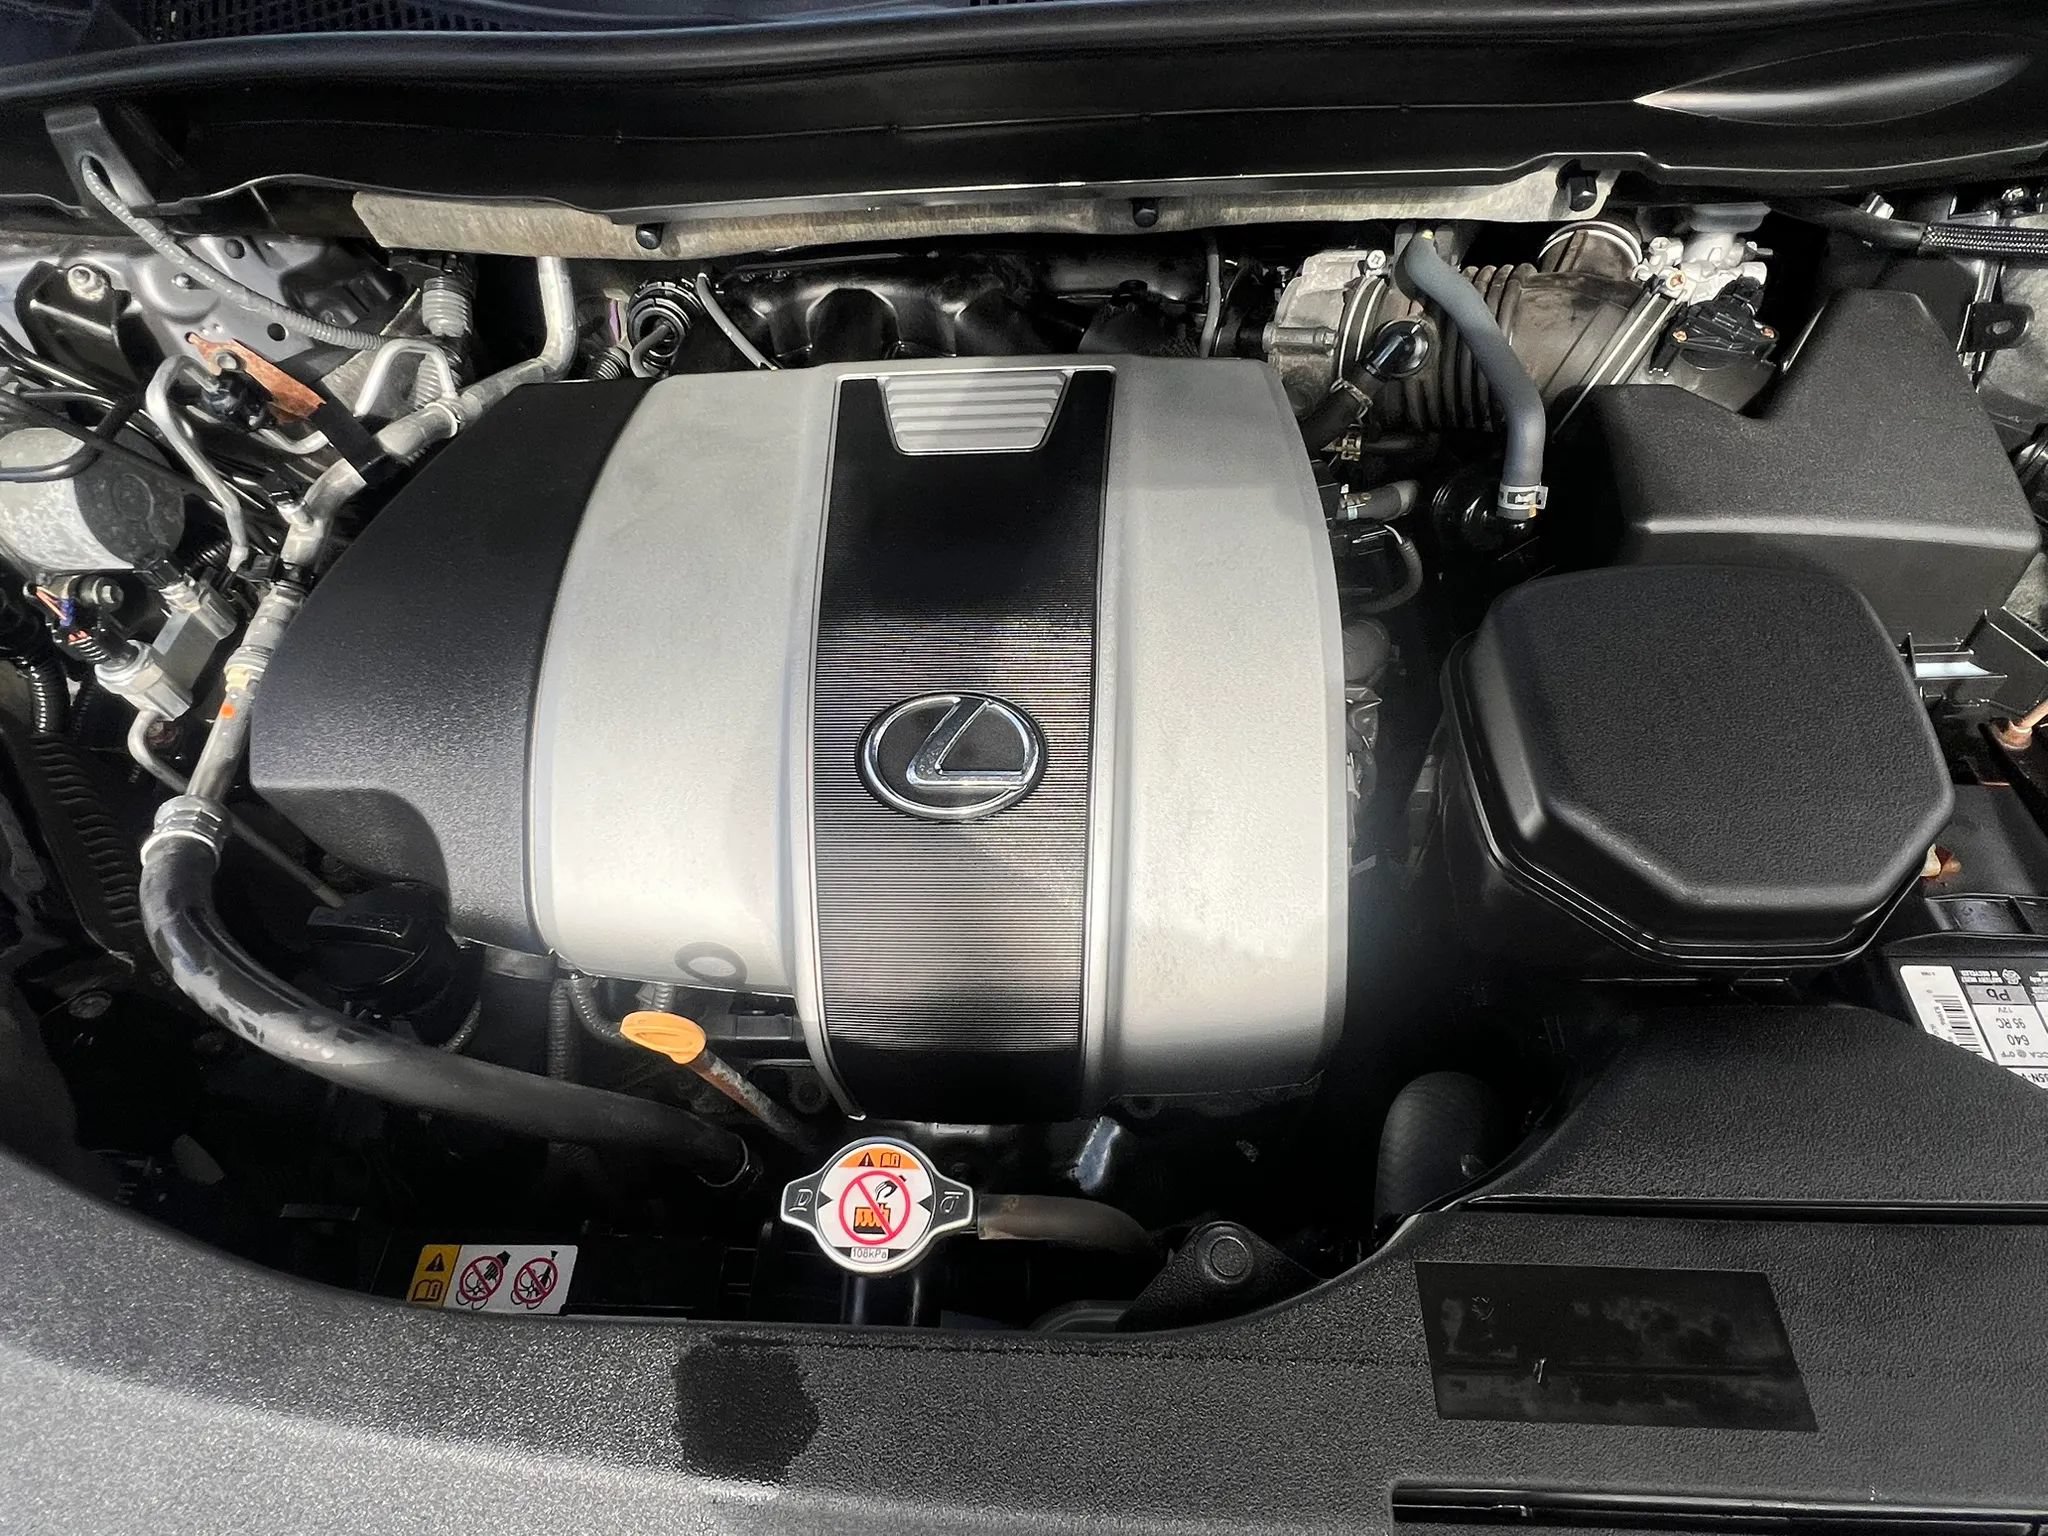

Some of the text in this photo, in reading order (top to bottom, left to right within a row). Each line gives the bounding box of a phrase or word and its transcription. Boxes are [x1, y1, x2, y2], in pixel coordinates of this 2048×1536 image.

[1986, 988, 2011, 1001] Pb
[1996, 1018, 2026, 1029] 95 RC
[2007, 1034, 2030, 1046] 640
[853, 1249, 888, 1260] 108kPa
